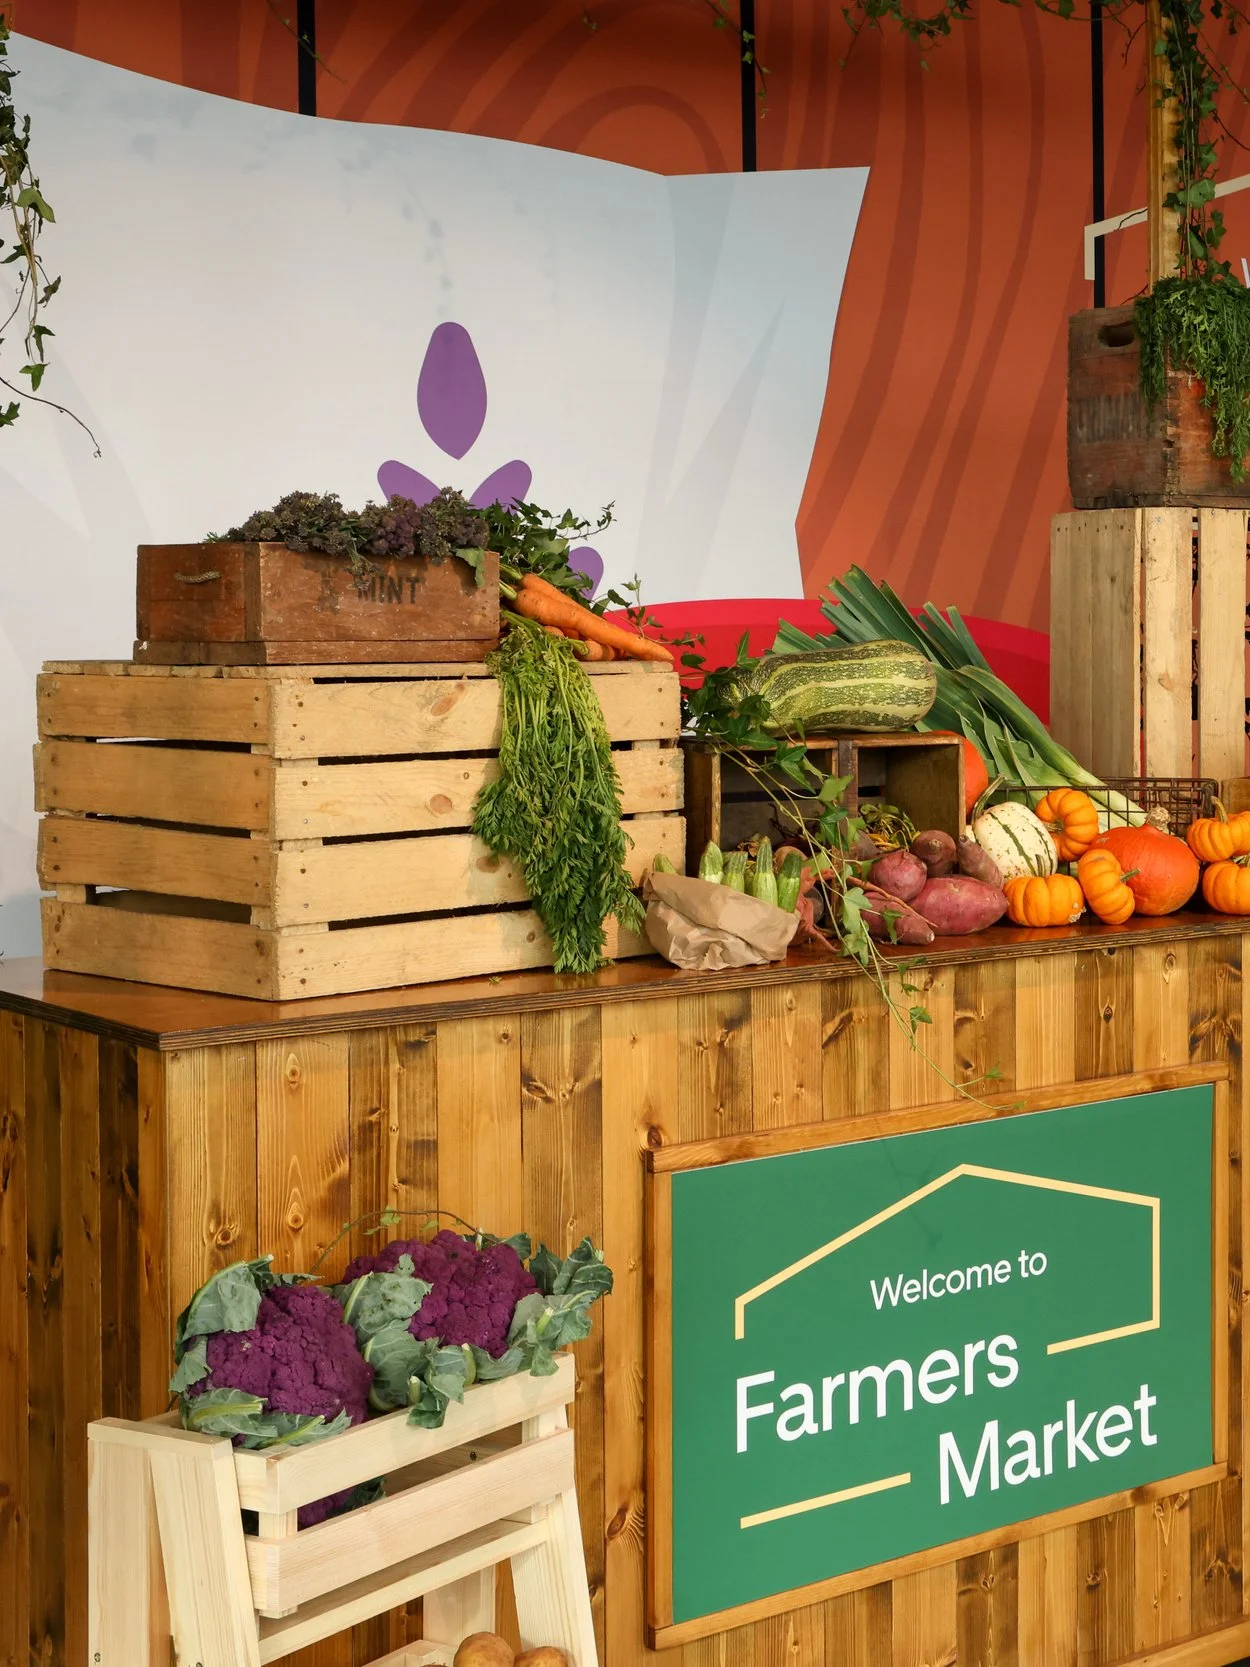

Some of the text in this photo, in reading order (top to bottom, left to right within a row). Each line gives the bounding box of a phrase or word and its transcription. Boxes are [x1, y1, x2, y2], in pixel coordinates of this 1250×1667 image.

[869, 1249, 1048, 1310] Welcome to
[736, 1333, 1020, 1454] Farmers
[938, 1382, 1158, 1506] Market
